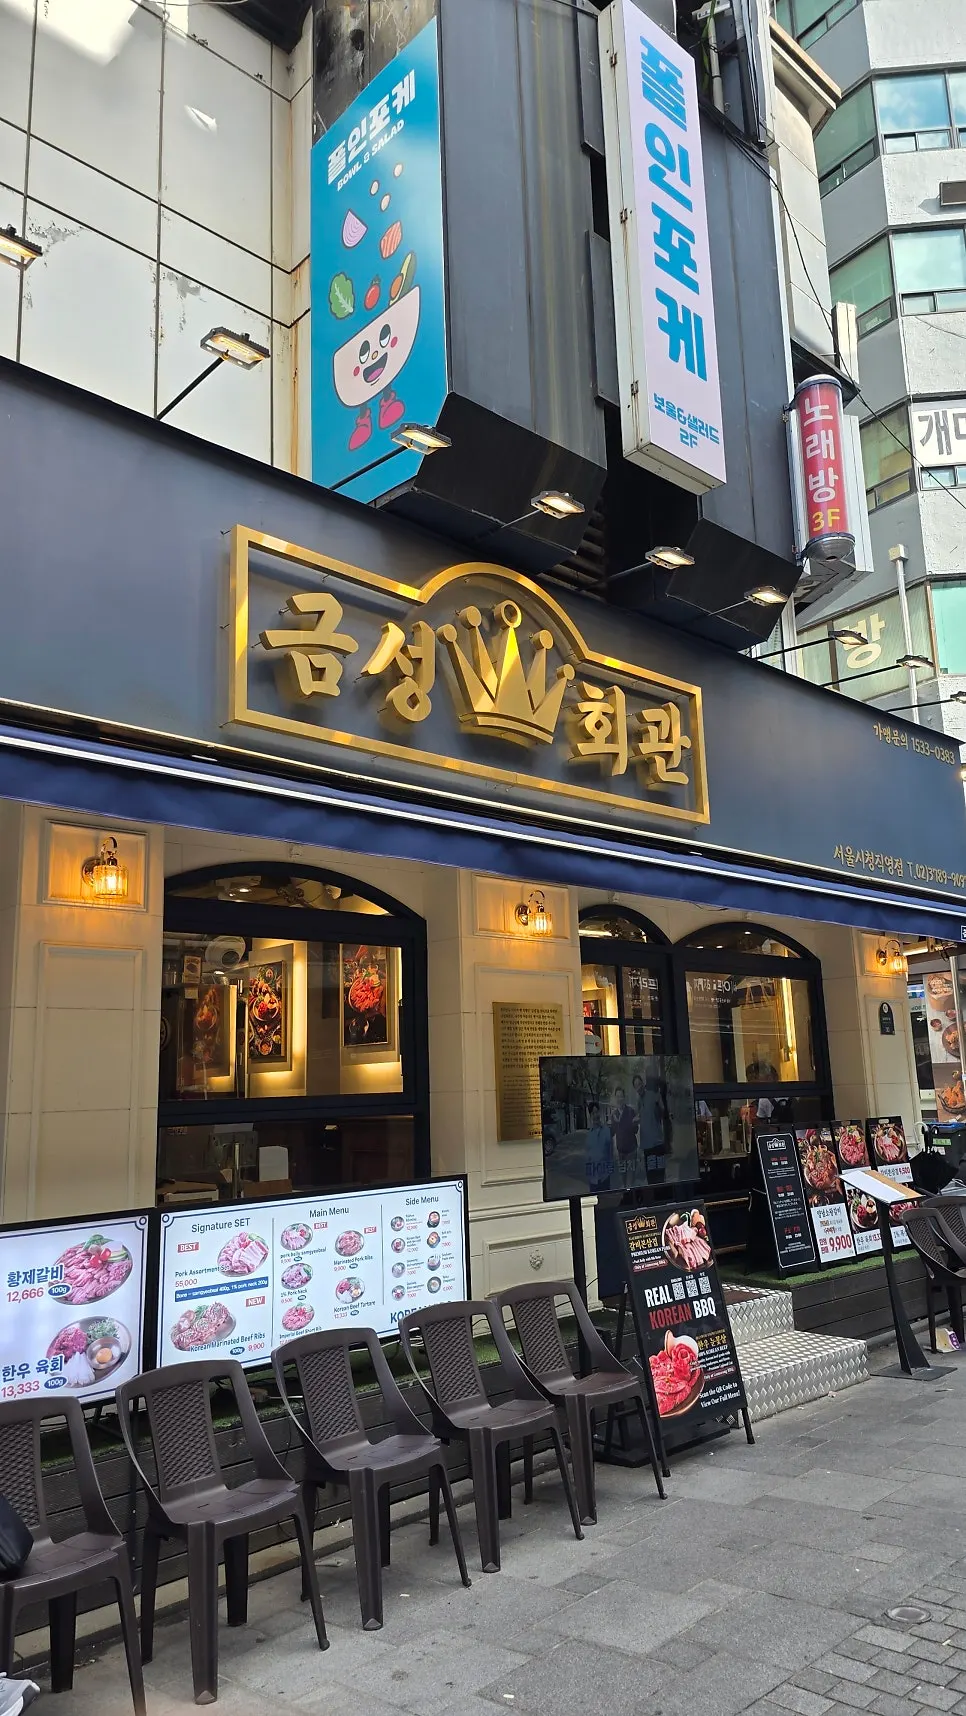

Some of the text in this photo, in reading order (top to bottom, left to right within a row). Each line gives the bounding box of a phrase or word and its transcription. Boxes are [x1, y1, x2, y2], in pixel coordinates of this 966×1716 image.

[327, 69, 416, 185] 폴인포케
[337, 161, 363, 192] BOWL
[371, 119, 405, 156] SALAD
[639, 34, 708, 383] 폴인포케
[653, 392, 720, 445] 보울&샐러드
[679, 427, 698, 448] 2F
[803, 397, 839, 503] 노래방
[812, 508, 841, 532] 3F
[258, 590, 693, 789] 금성 회관
[872, 722, 955, 765] 가맹문의 1533-0383
[833, 844, 904, 877] 서울시청직영점
[405, 1196, 439, 1206] Side Menu
[309, 1207, 350, 1218] Main Menu
[191, 1217, 251, 1234] Signature SET
[180, 1243, 197, 1252] BEST
[828, 1233, 853, 1253] 9,900
[6, 1264, 64, 1288] 황제갈비
[175, 1270, 188, 1278] Pork
[189, 1266, 220, 1275] Assortment
[51, 1286, 67, 1294] 100g
[175, 1278, 198, 1288] 55,000
[6, 1287, 44, 1303] 12,666
[247, 1296, 263, 1306] NEW
[644, 1284, 674, 1308] REAL
[649, 1296, 717, 1330] KOREAN BBQ
[210, 1337, 240, 1348] Marinated
[240, 1334, 253, 1343] Beef
[254, 1332, 266, 1340] Ribs
[2, 1355, 64, 1383] 한우 육회
[1, 1380, 40, 1398] 13,333
[47, 1378, 64, 1387] 100g
[699, 1390, 709, 1399] Scan
[708, 1388, 716, 1396] the
[716, 1385, 723, 1394] QR
[711, 1397, 719, 1405] Our
[719, 1394, 728, 1402] Full
